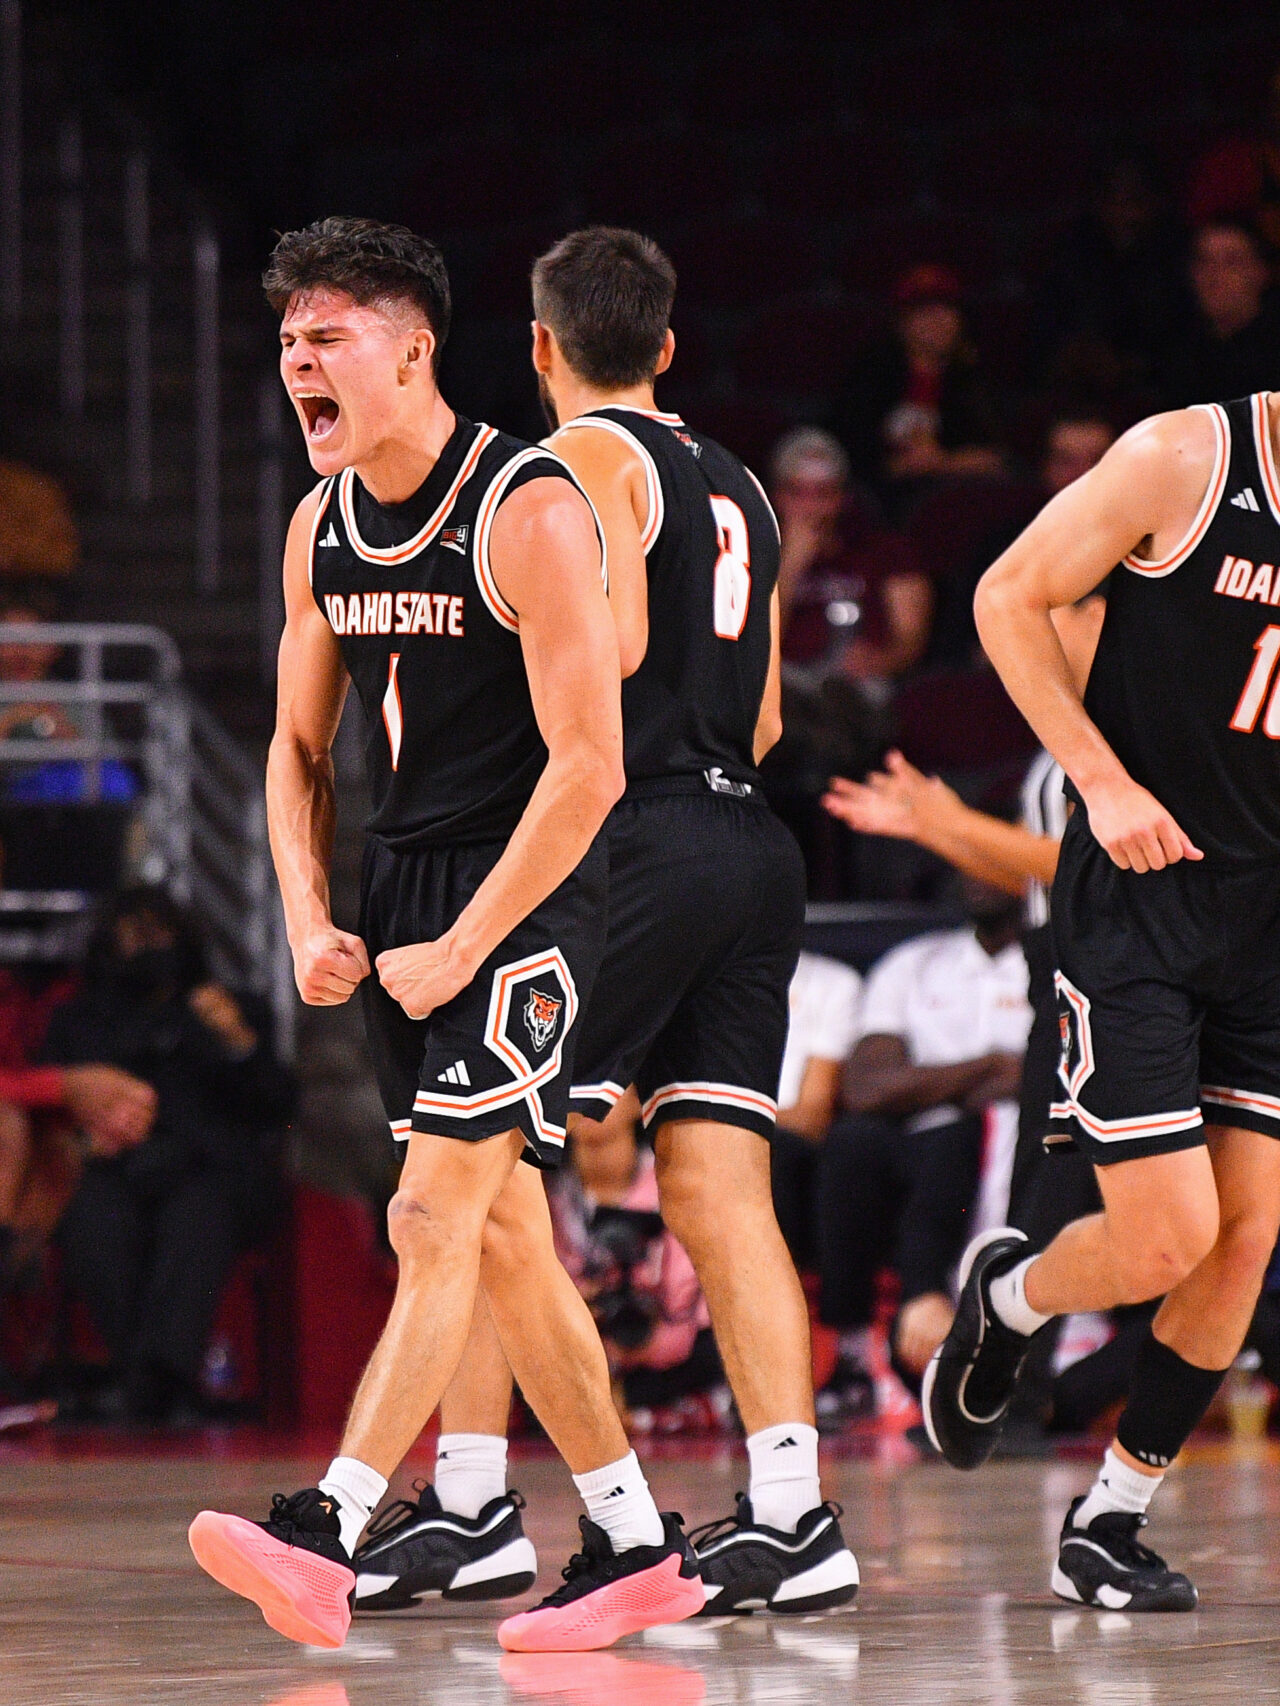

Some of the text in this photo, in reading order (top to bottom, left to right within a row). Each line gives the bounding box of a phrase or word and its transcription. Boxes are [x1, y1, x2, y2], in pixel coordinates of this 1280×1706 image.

[323, 591, 465, 637] IDAHO STATE
[709, 493, 751, 641] 8
